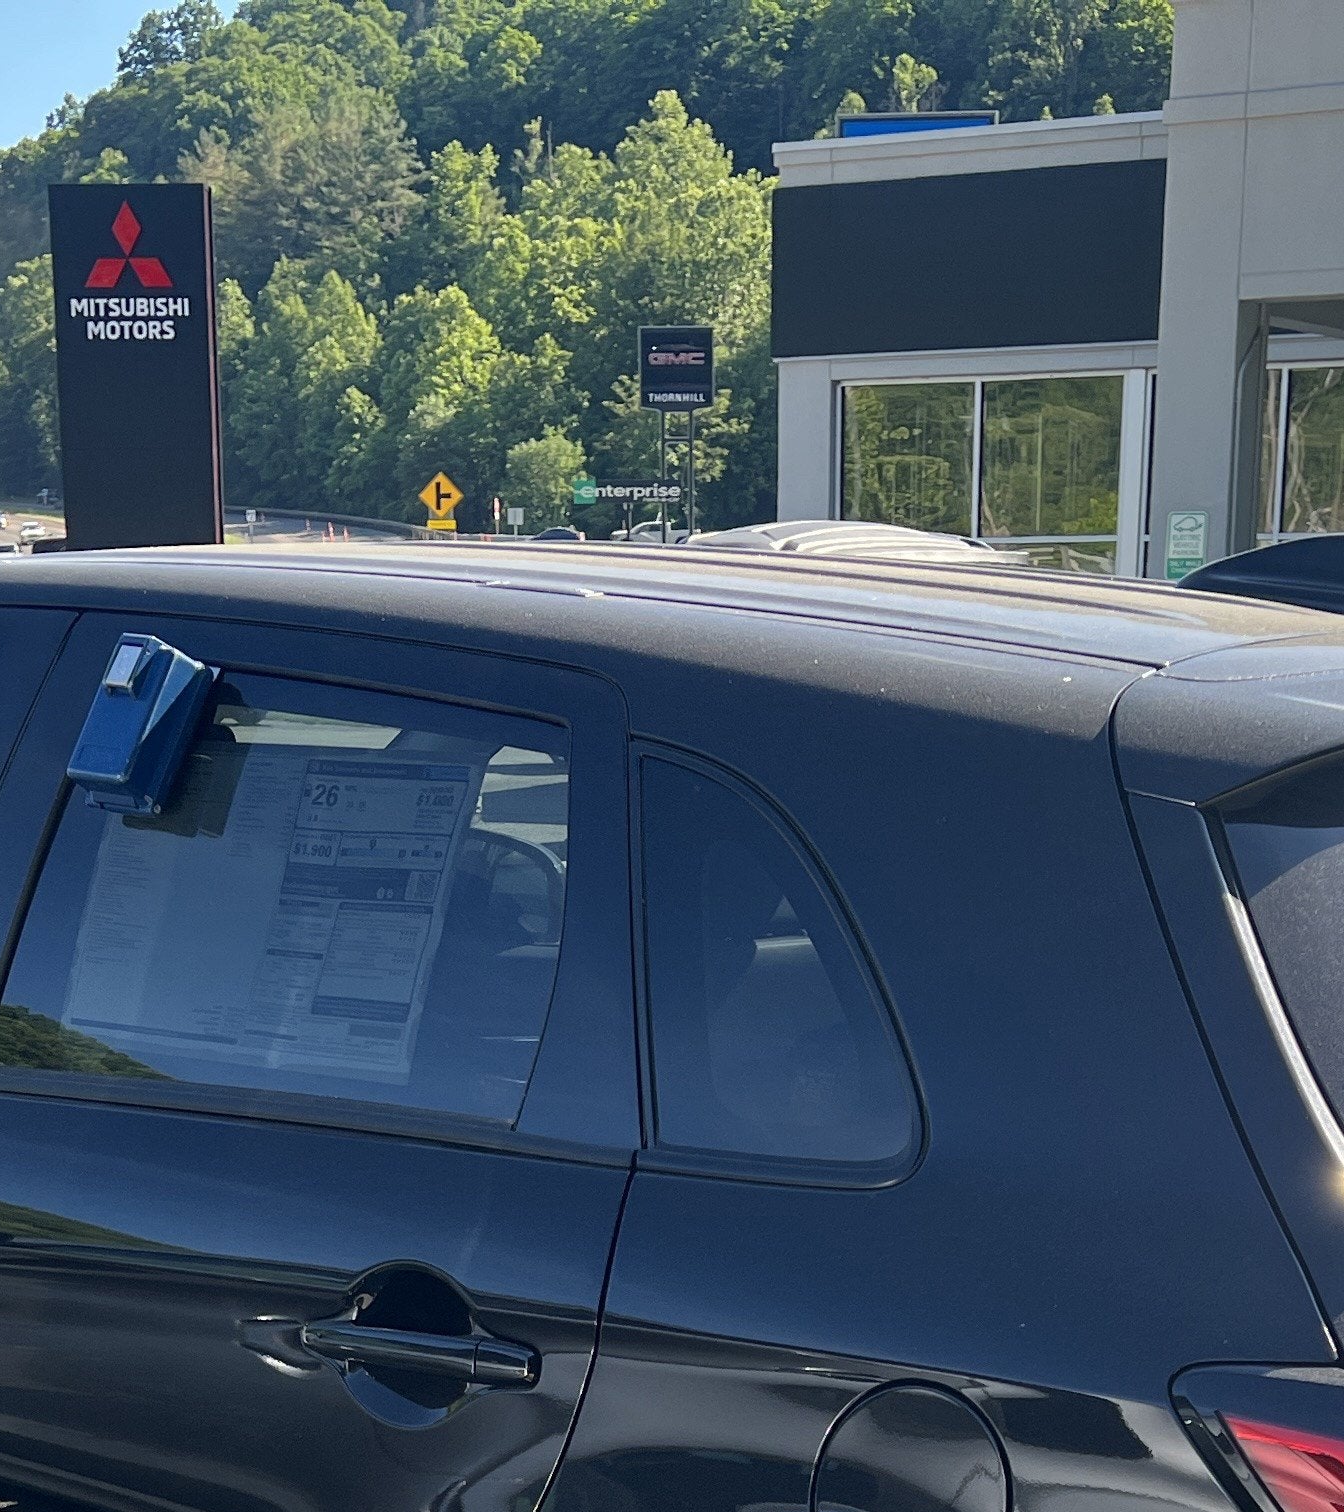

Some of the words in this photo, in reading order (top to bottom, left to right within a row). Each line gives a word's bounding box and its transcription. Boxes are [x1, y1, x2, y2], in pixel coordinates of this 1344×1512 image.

[70, 297, 190, 317] MITSUBISHI
[86, 320, 175, 340] MOTORS
[648, 352, 705, 365] GMC
[647, 392, 706, 402] THORNHILL
[575, 482, 681, 500] enterprise
[311, 783, 340, 807] 26
